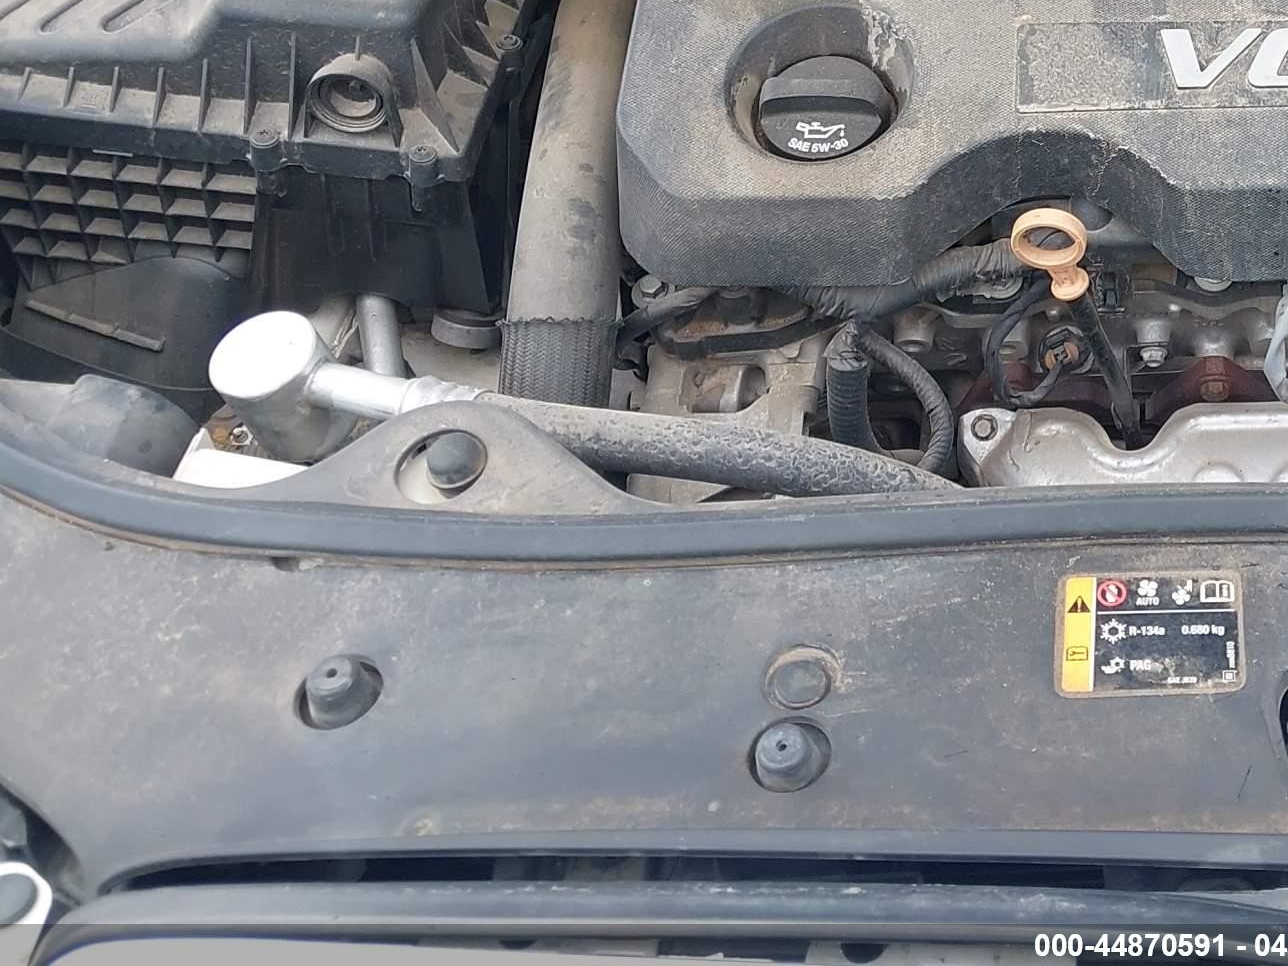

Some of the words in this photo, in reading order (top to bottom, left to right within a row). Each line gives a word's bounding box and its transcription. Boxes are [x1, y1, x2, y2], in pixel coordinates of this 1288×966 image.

[788, 138, 811, 152] SAE
[812, 138, 848, 152] 5W-30
[1136, 597, 1160, 606] AUTO
[1128, 625, 1166, 636] R-134a
[1212, 624, 1225, 637] kg
[1130, 659, 1152, 671] PAG
